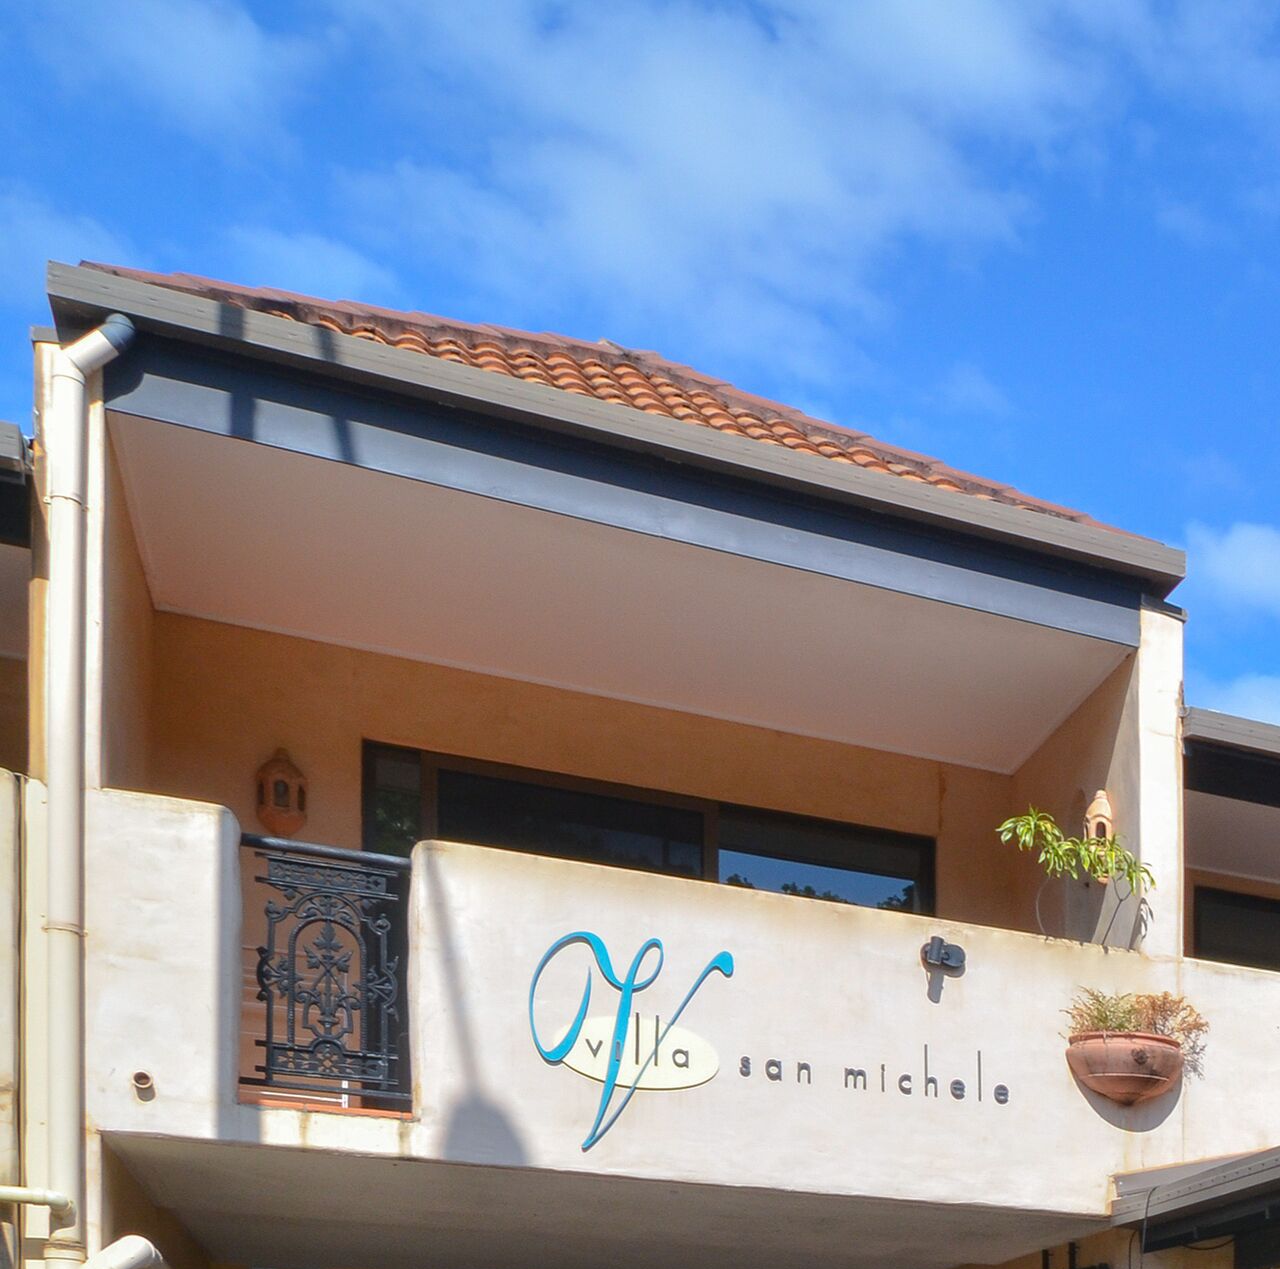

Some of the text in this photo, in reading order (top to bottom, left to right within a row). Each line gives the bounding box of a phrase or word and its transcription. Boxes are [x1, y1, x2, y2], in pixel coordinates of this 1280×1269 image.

[585, 1011, 1011, 1106] villa san michele
